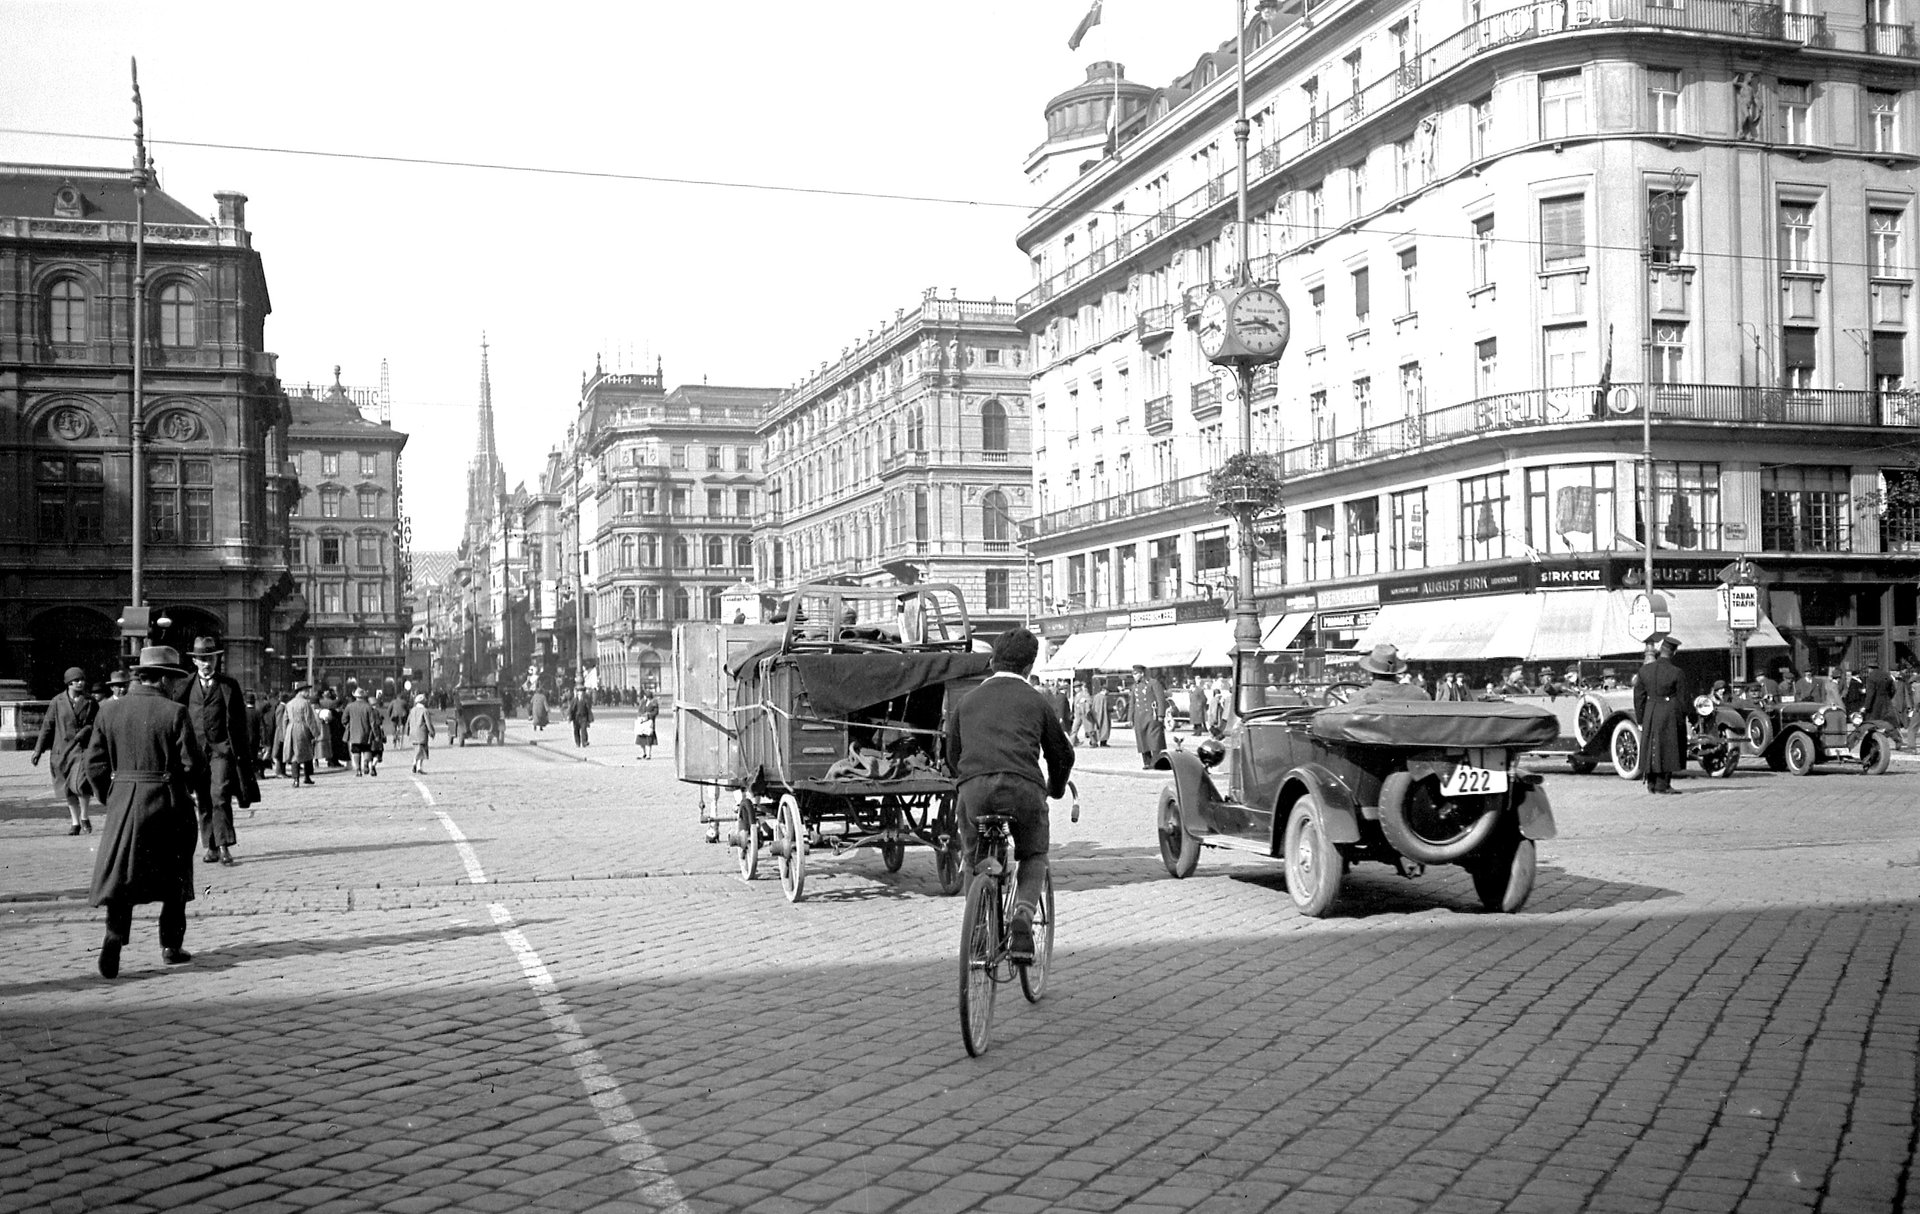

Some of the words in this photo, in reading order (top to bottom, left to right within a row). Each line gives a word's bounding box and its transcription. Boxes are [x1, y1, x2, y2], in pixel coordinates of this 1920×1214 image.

[1698, 568, 1723, 581] SIR
[1422, 579, 1460, 594] AUGUST
[1463, 576, 1488, 590] SIRK
[1732, 592, 1755, 600] TABAK
[1732, 600, 1756, 608] TRAFIK
[1458, 771, 1490, 792] 222
